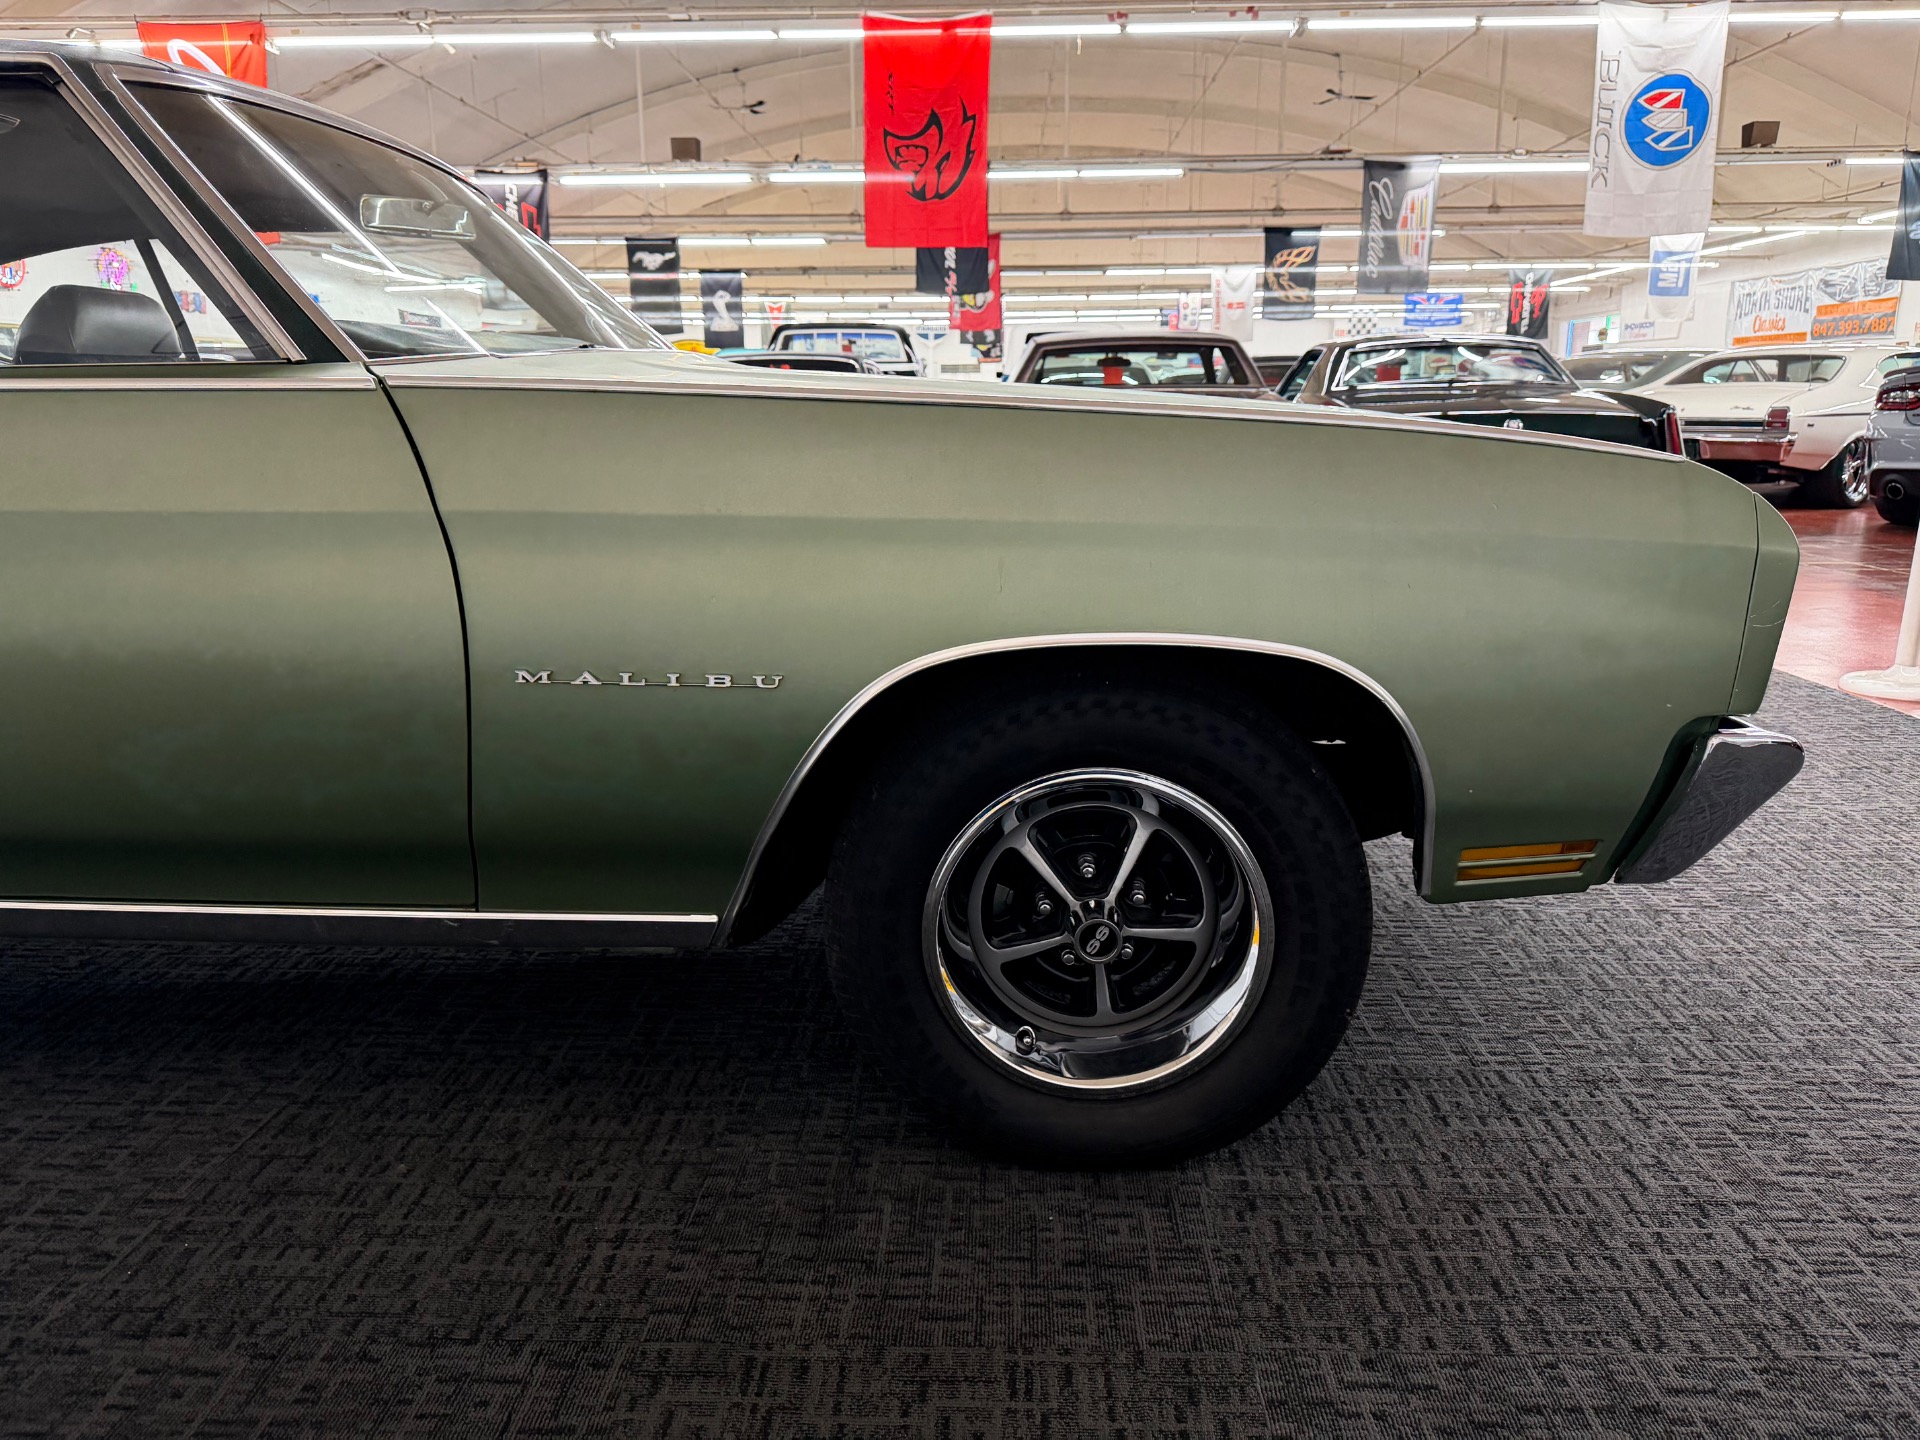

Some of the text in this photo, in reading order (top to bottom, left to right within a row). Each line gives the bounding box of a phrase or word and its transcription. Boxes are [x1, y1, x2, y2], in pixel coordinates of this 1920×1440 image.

[1591, 50, 1622, 188] BUICK
[1365, 177, 1394, 279] Cadillac
[1734, 289, 1771, 321] NORTH
[1774, 285, 1812, 313] SHORE
[1753, 312, 1786, 333] Classics
[1813, 317, 1895, 337] 847.393.7887
[515, 669, 784, 689] MALIBU
[1086, 925, 1110, 955] SS
